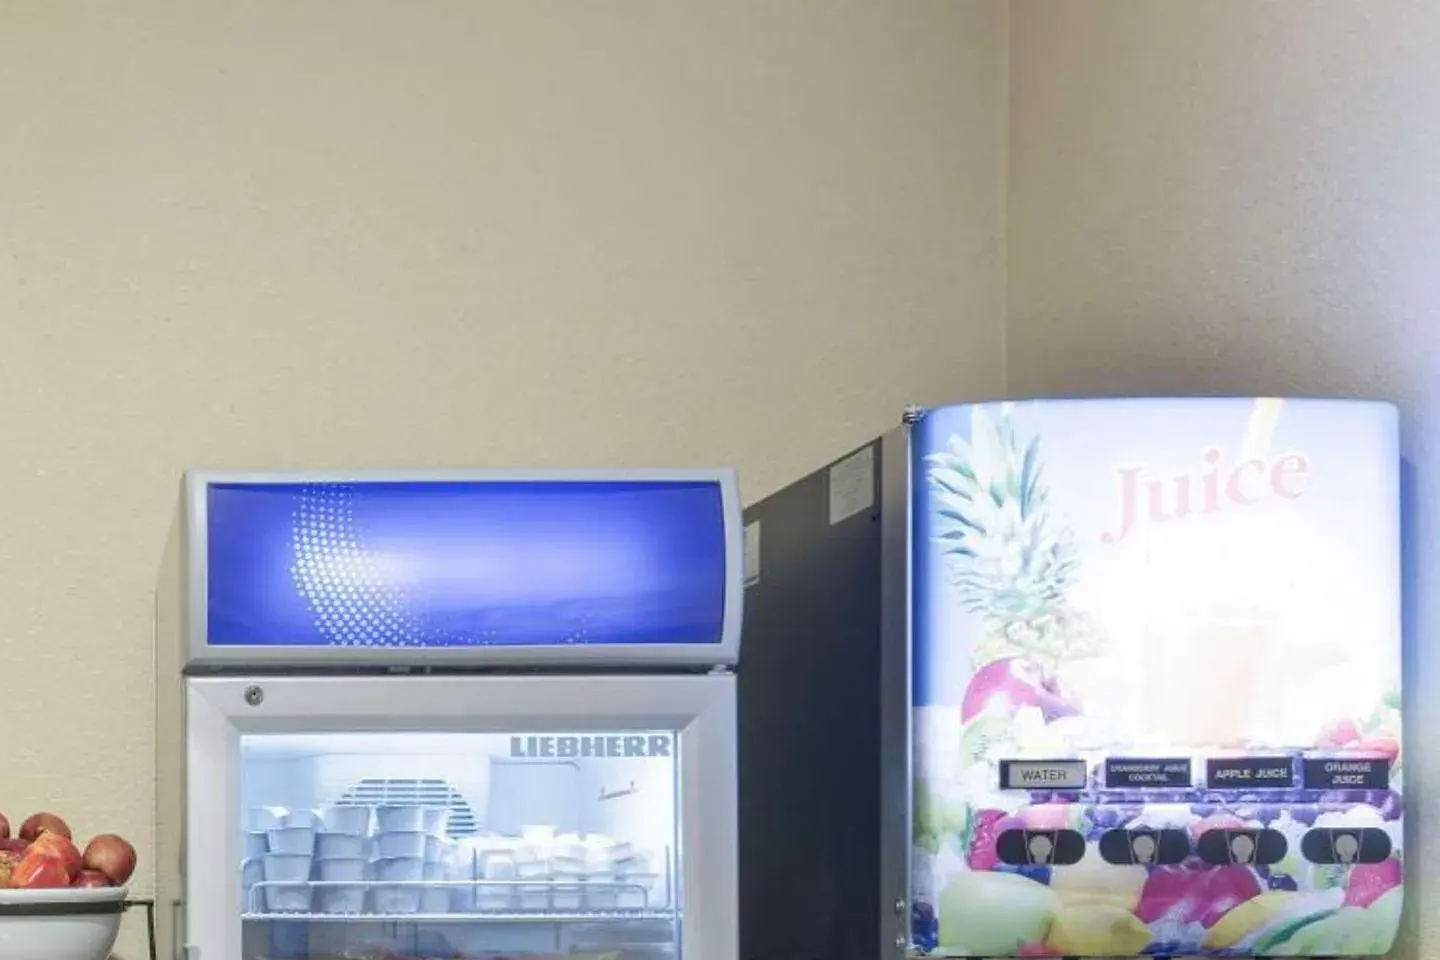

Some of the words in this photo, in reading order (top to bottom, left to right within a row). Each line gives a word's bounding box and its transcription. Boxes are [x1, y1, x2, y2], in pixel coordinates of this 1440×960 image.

[1100, 447, 1310, 543] Juice
[510, 735, 671, 757] LIEBHERR
[1214, 769, 1251, 779] APPLE
[1256, 768, 1288, 778] JUICE
[1324, 762, 1372, 773] ORANGE
[1021, 768, 1067, 781] WATER
[1331, 775, 1364, 784] JUICE
